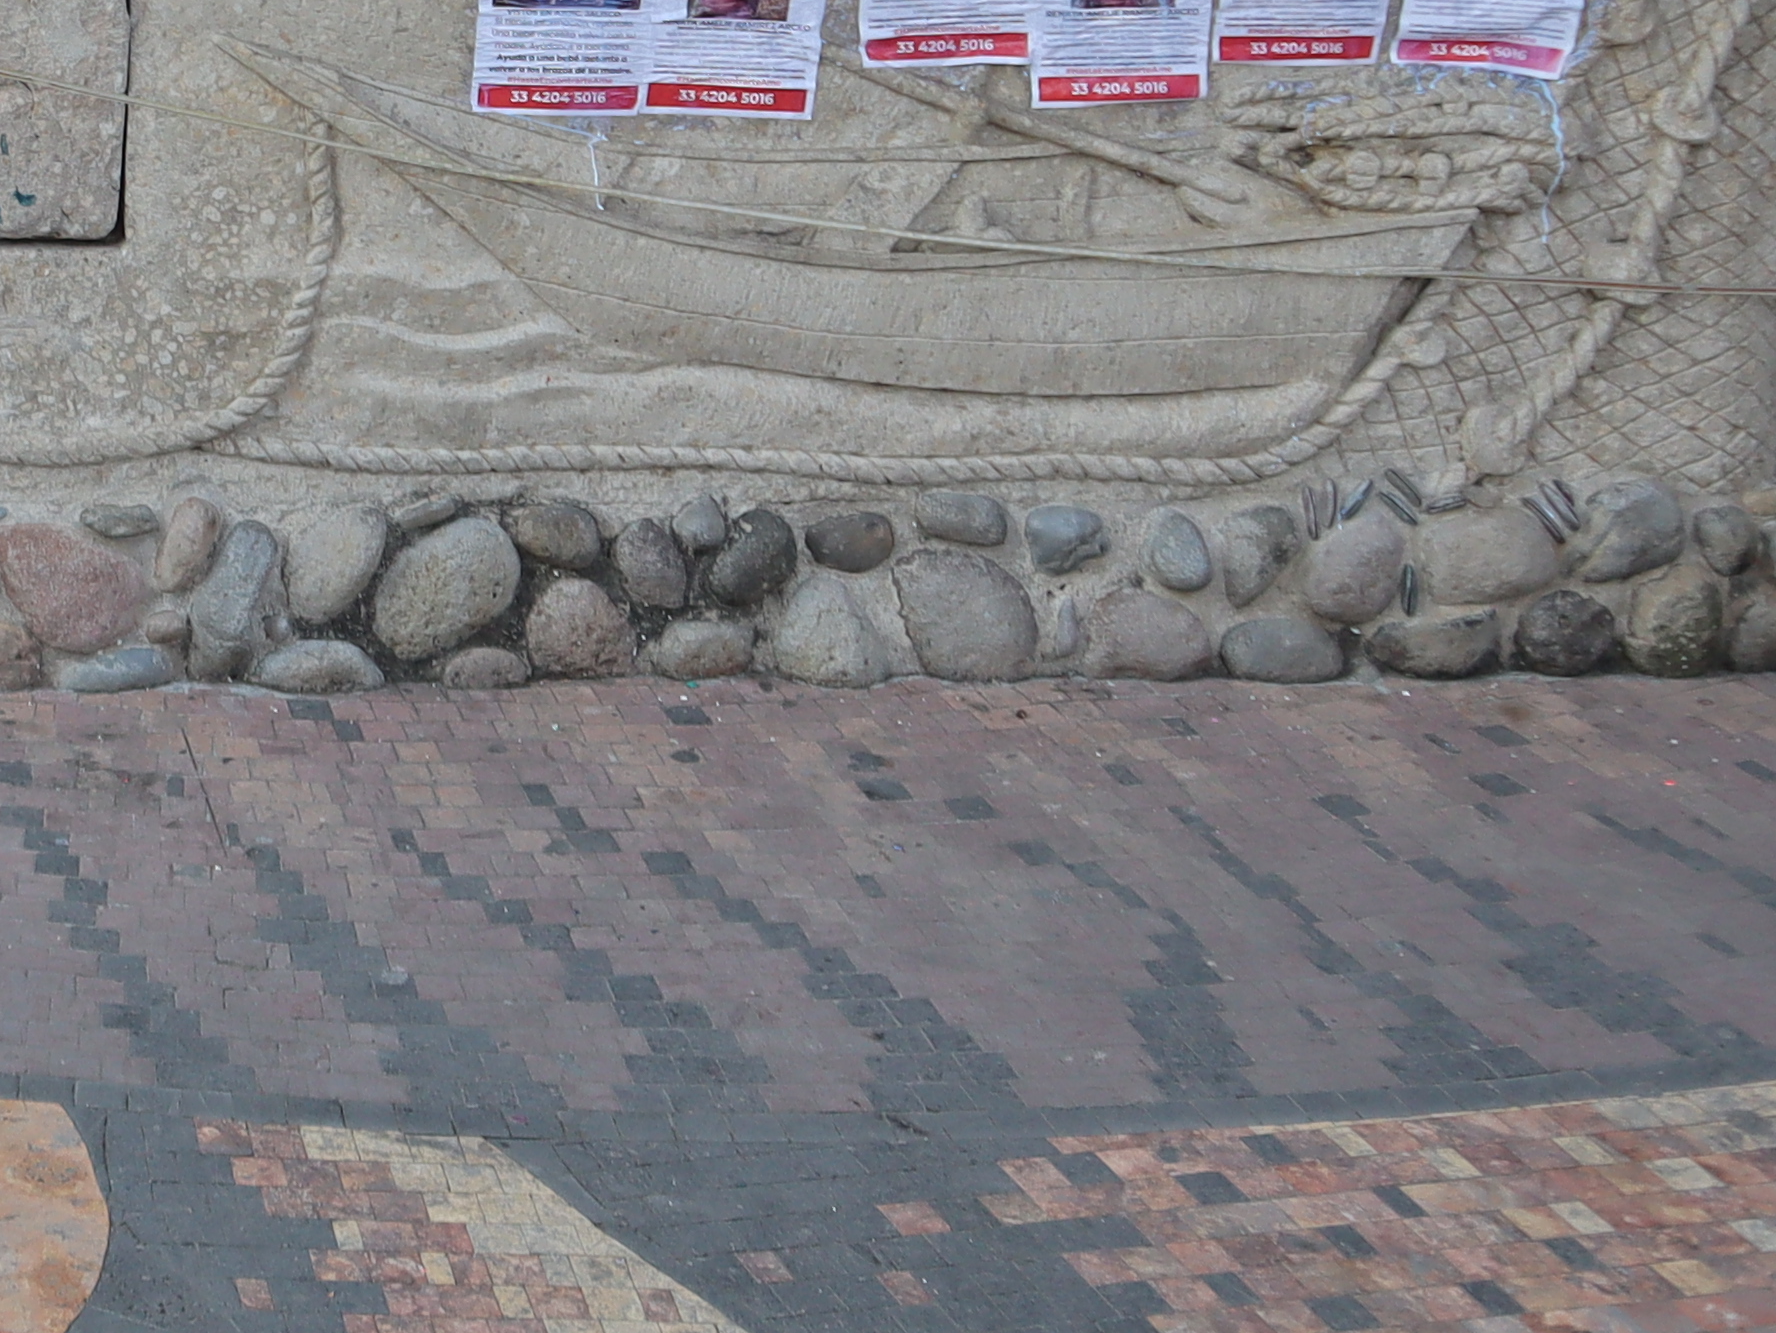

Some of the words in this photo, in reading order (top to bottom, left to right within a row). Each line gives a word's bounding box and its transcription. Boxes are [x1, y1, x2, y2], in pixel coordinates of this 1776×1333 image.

[896, 40, 914, 54] 33
[918, 39, 957, 53] 4204
[959, 38, 995, 51] 5016
[1249, 41, 1268, 55] 33
[1271, 42, 1308, 55] 4204
[1311, 41, 1344, 54] 5016
[1429, 42, 1448, 56] 33
[1451, 44, 1490, 57] 4204
[1070, 82, 1089, 96] 33
[1092, 82, 1131, 95] 4204
[1134, 81, 1168, 94] 5016
[510, 90, 530, 103] 33
[532, 90, 571, 103] 4204
[573, 91, 607, 104] 5016
[678, 89, 697, 102] 33
[699, 90, 738, 104] 4204
[740, 92, 775, 105] 5016
